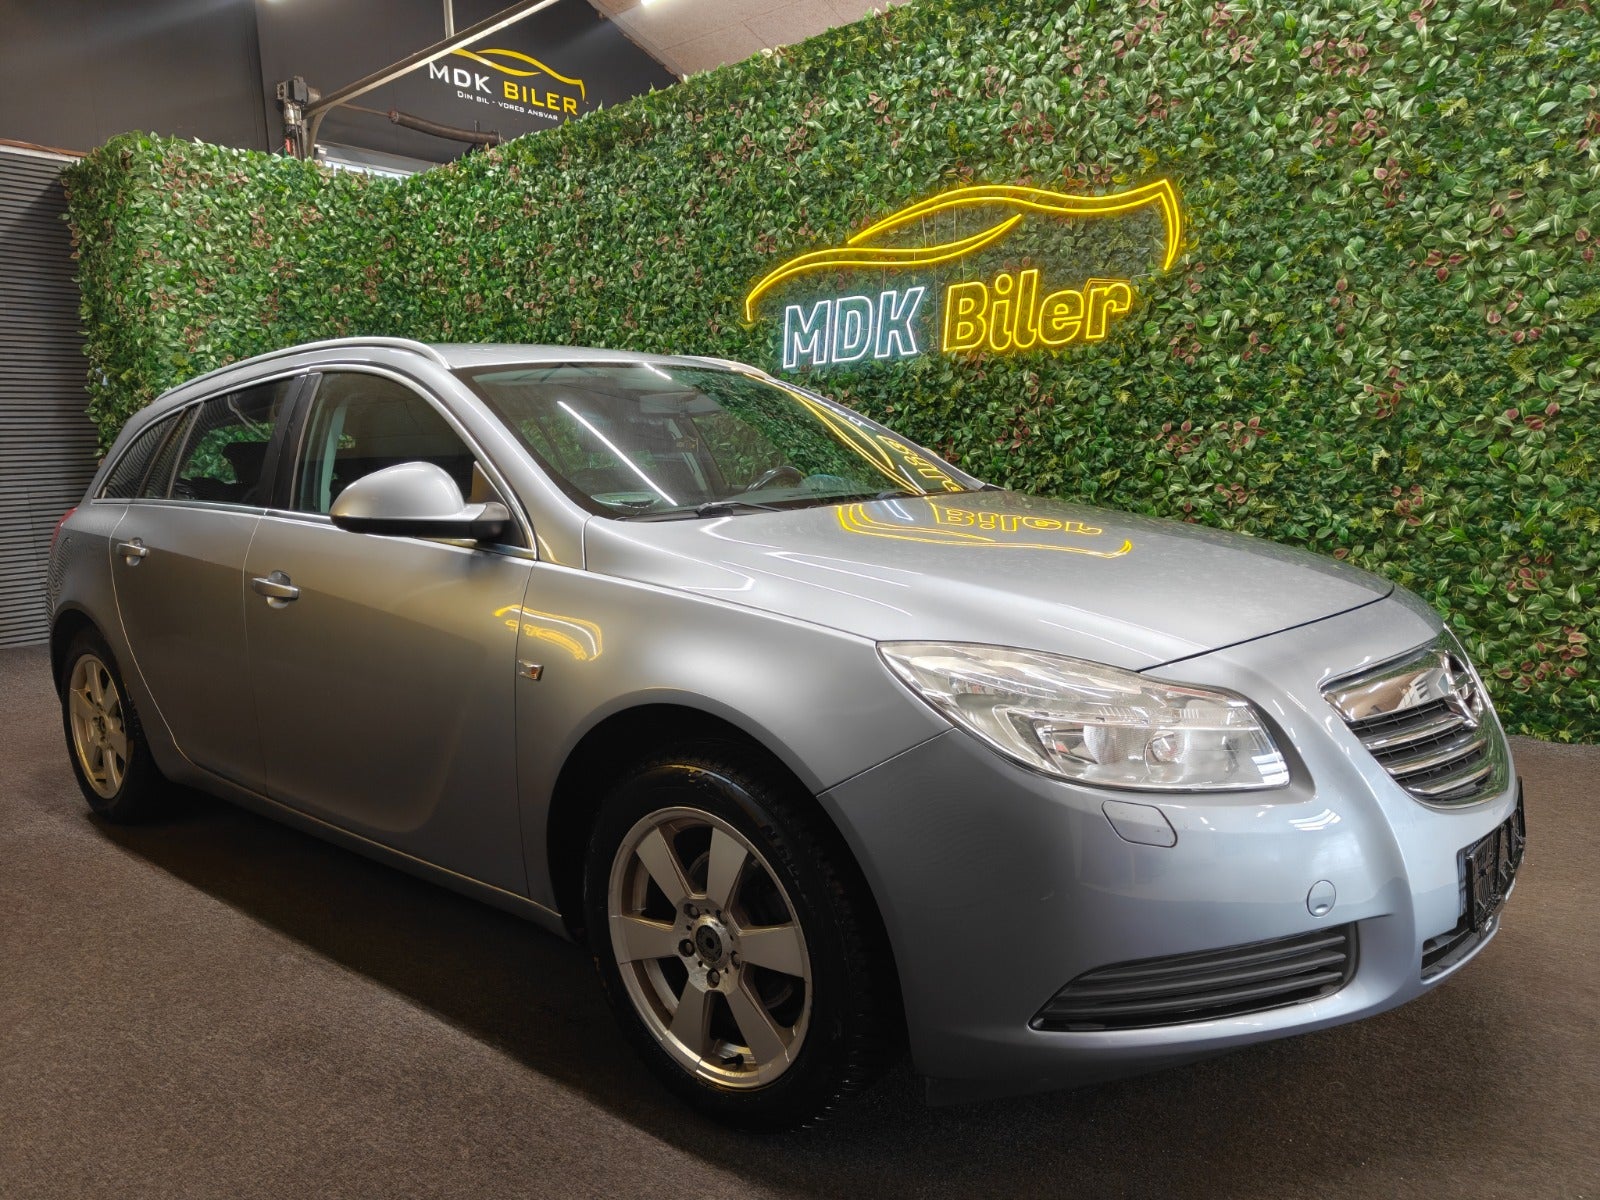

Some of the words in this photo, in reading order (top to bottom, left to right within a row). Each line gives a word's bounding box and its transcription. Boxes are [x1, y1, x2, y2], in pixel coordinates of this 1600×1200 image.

[428, 60, 492, 94] MDK
[503, 80, 578, 116] BILER
[476, 96, 490, 105] BIL
[498, 101, 525, 113] VORES
[527, 109, 558, 121] ANSVAR
[782, 285, 926, 369] MDK
[943, 268, 1132, 353] Biler
